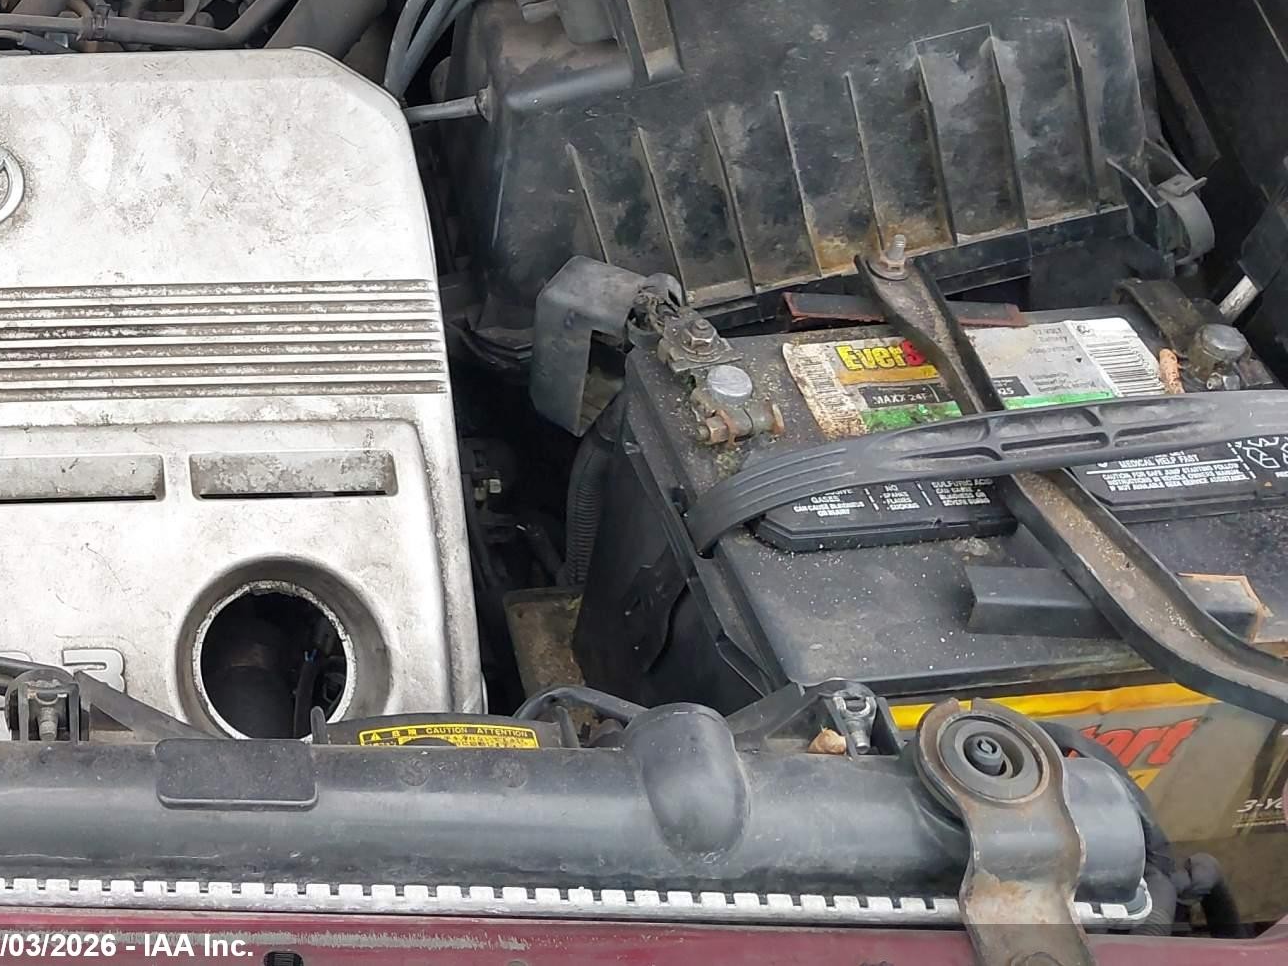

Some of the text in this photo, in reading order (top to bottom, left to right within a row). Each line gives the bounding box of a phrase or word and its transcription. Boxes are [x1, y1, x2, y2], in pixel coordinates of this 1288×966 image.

[835, 339, 927, 371] EverS
[1118, 456, 1155, 468] MEDICAL
[1155, 456, 1176, 466] HELP
[1177, 454, 1200, 463] FAST
[884, 484, 898, 492] NO
[425, 726, 468, 736] CAUTION
[476, 727, 528, 738] ATTENTION
